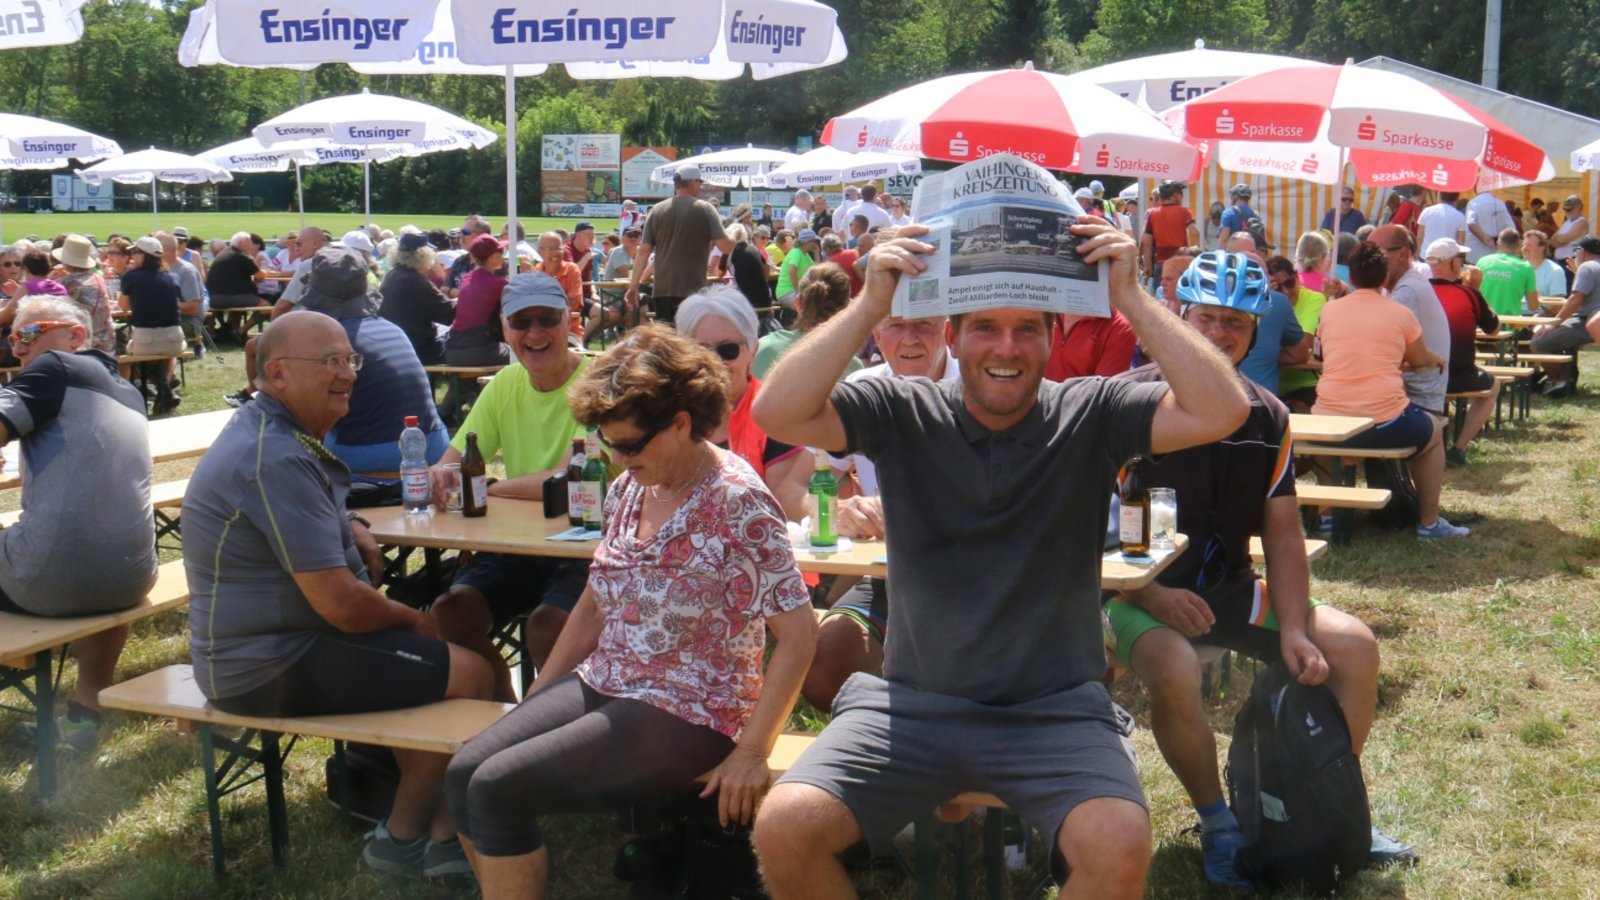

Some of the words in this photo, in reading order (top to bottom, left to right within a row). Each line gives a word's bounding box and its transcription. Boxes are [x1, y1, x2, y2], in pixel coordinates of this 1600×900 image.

[260, 8, 410, 50] Ensinger
[491, 8, 676, 49] Ensinger
[730, 9, 807, 54] Ensinger
[274, 126, 326, 136] Ensinger
[349, 126, 412, 140] Ensinger
[1241, 122, 1304, 138] Sparkasse
[23, 140, 77, 154] Ensinger
[1382, 129, 1454, 151] Sparkasse
[698, 163, 751, 175] Ensinger
[1113, 156, 1170, 173] Sparkasse
[1491, 151, 1522, 173] Sparkasse
[796, 175, 833, 184] Ensinger
[851, 168, 888, 179] Ensinger
[965, 161, 1050, 183] VAIHINGER
[953, 176, 1058, 199] KREISZEITUNG
[948, 286, 971, 296] Ampel
[972, 283, 993, 292] einigt
[994, 282, 1009, 290] sich
[1010, 282, 1024, 290] auf
[1025, 283, 1057, 293] Haushalt
[1028, 292, 1050, 302] bleibt
